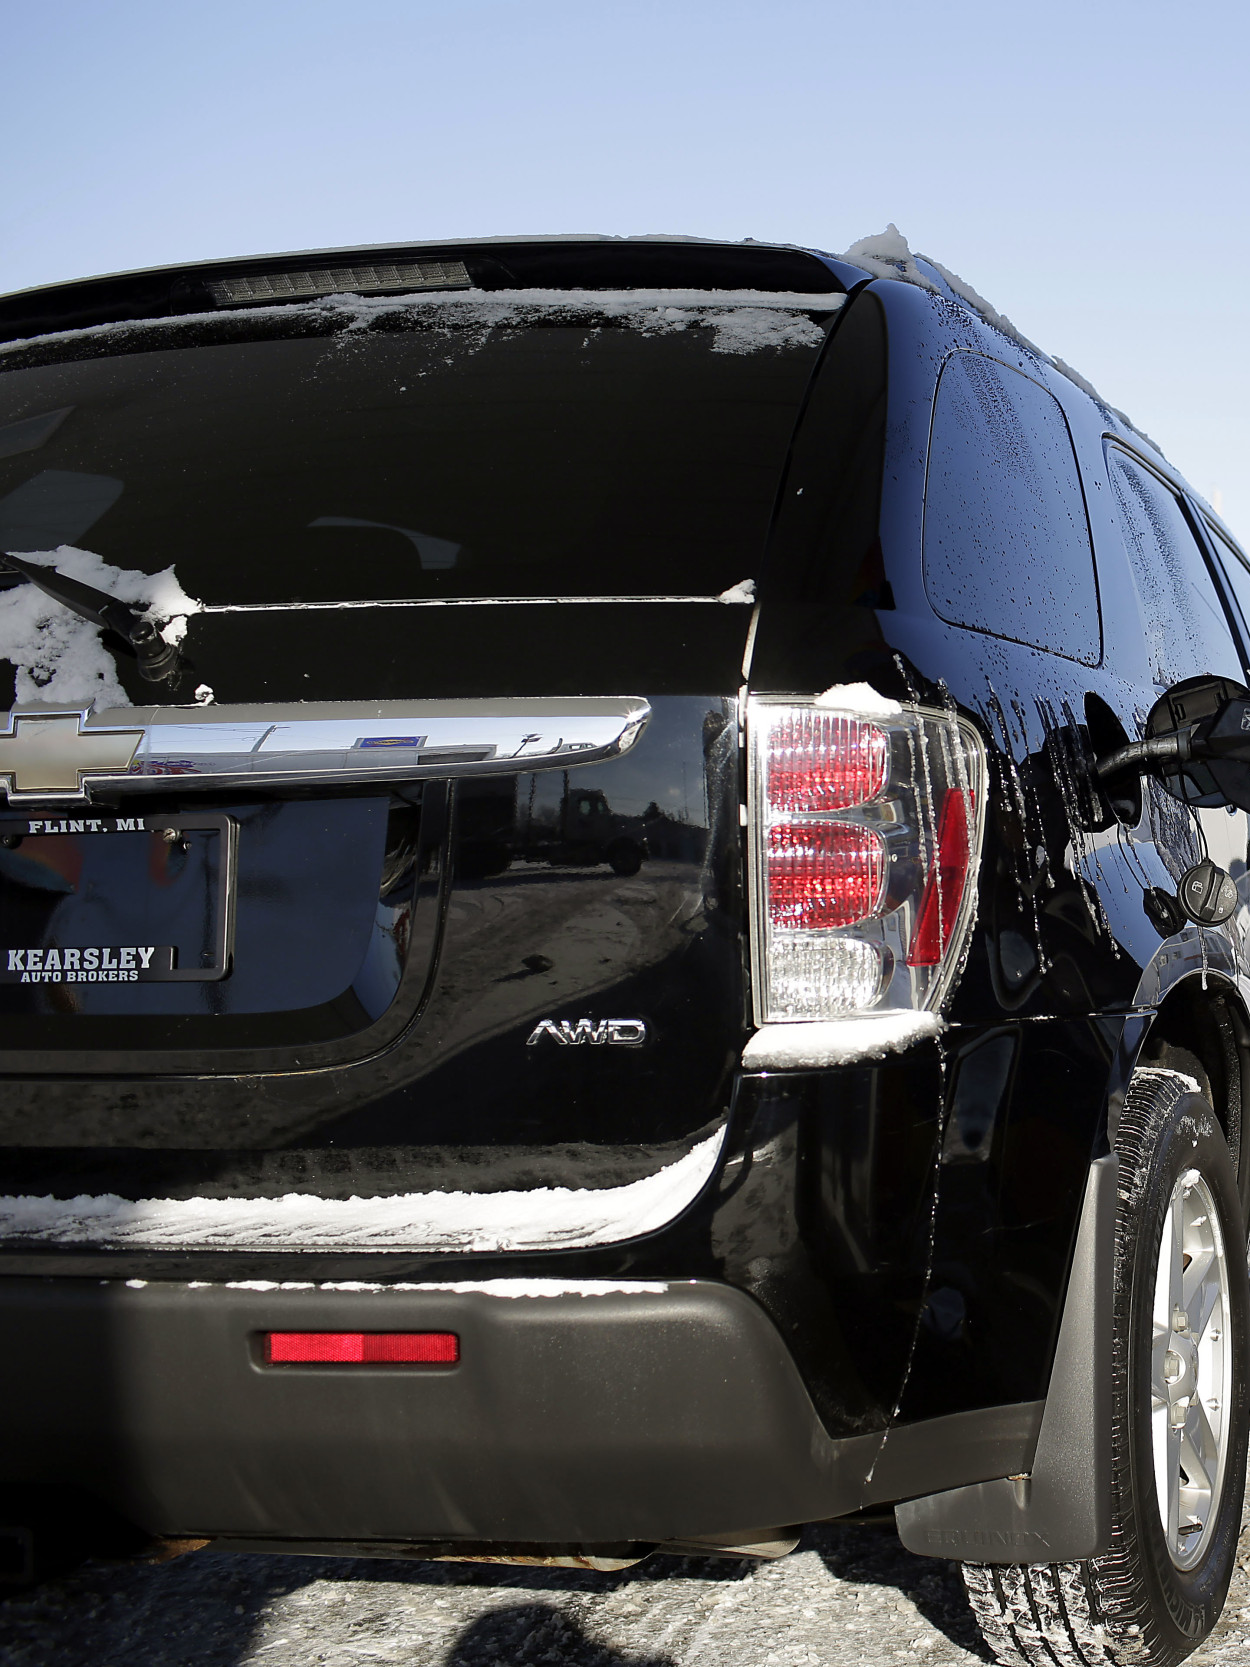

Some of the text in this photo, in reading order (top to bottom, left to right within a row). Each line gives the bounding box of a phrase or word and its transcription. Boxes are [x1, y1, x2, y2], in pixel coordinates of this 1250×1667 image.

[29, 818, 145, 833] FLINT, MI
[8, 947, 155, 971] KEARSLEY
[21, 970, 139, 983] AUTO BROKERS
[526, 1019, 646, 1045] AWD
